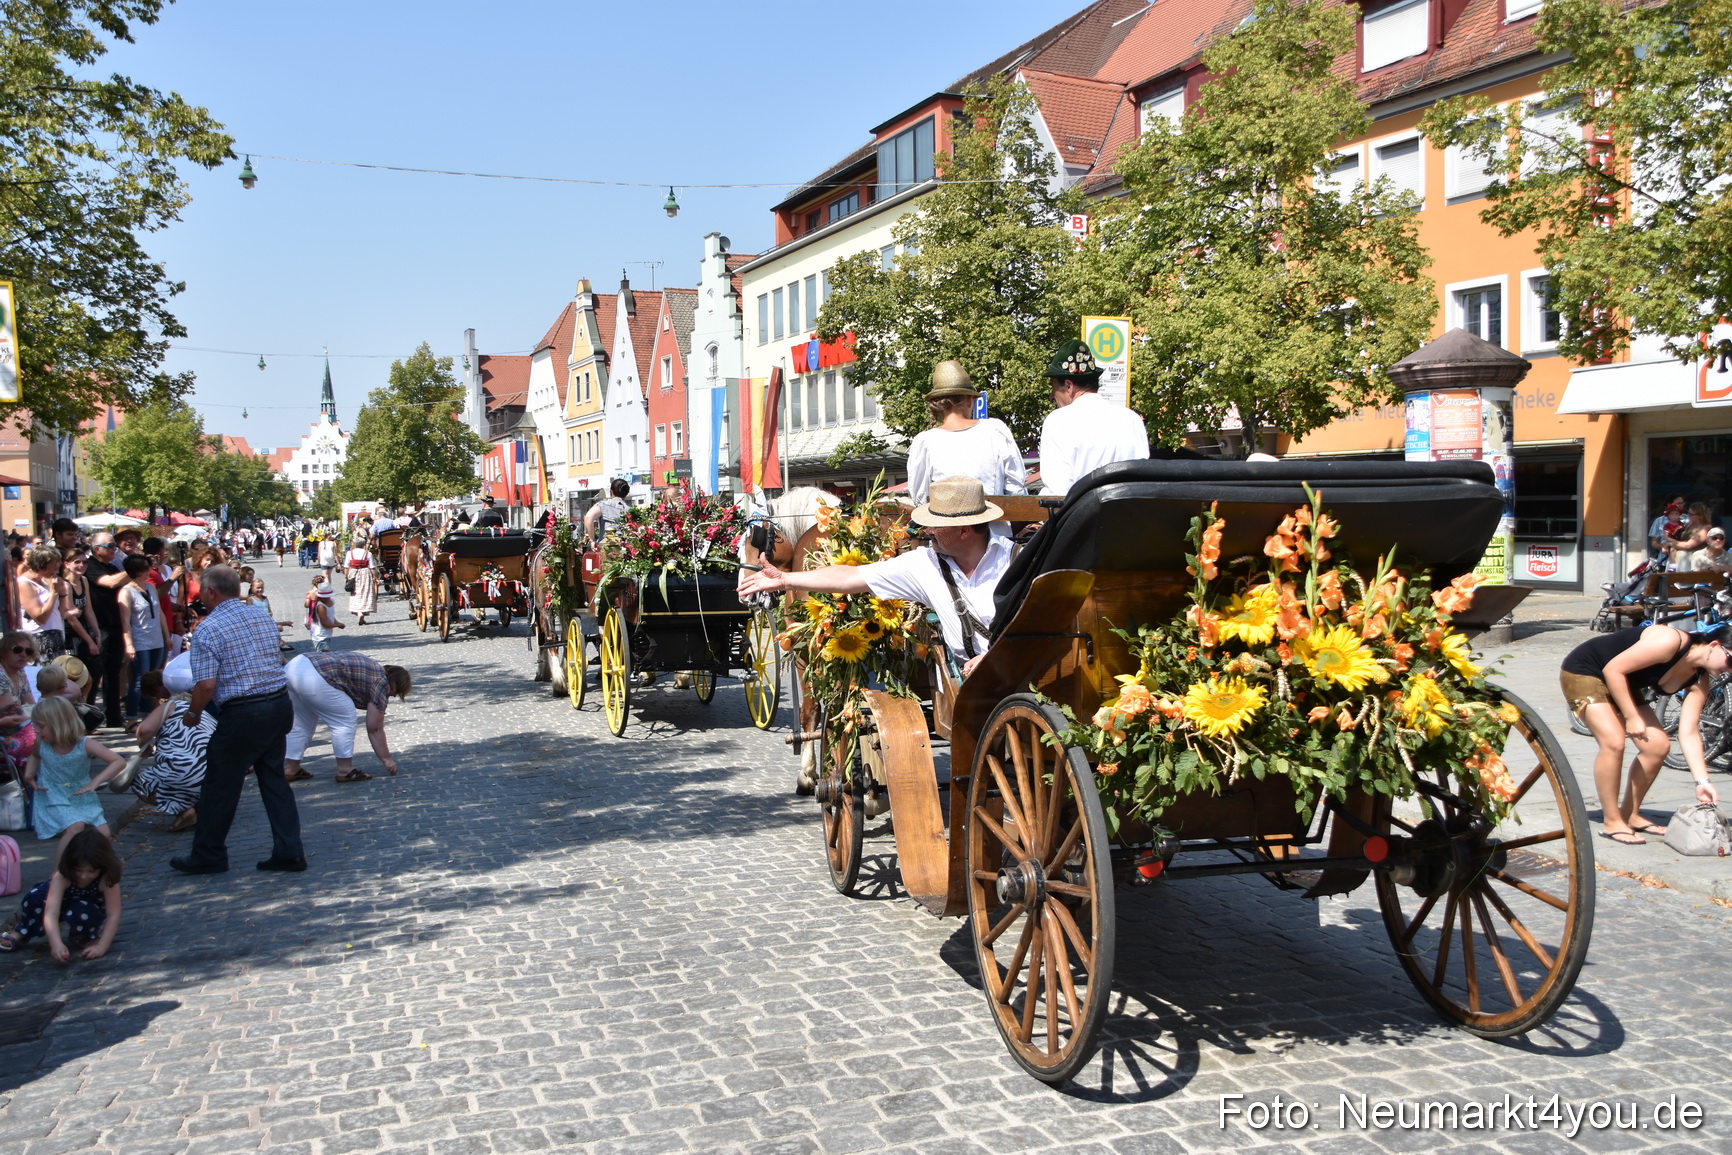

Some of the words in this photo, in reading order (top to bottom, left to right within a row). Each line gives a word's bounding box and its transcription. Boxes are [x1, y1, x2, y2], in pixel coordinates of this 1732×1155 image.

[1072, 216, 1084, 229] B
[1098, 331, 1115, 353] H
[976, 396, 984, 419] P
[1374, 402, 1406, 420] Metz
[1514, 387, 1556, 409] heke
[1485, 546, 1504, 556] est
[1531, 550, 1554, 559] JURA
[1479, 556, 1504, 567] ARTY
[1530, 562, 1556, 572] Fleisch
